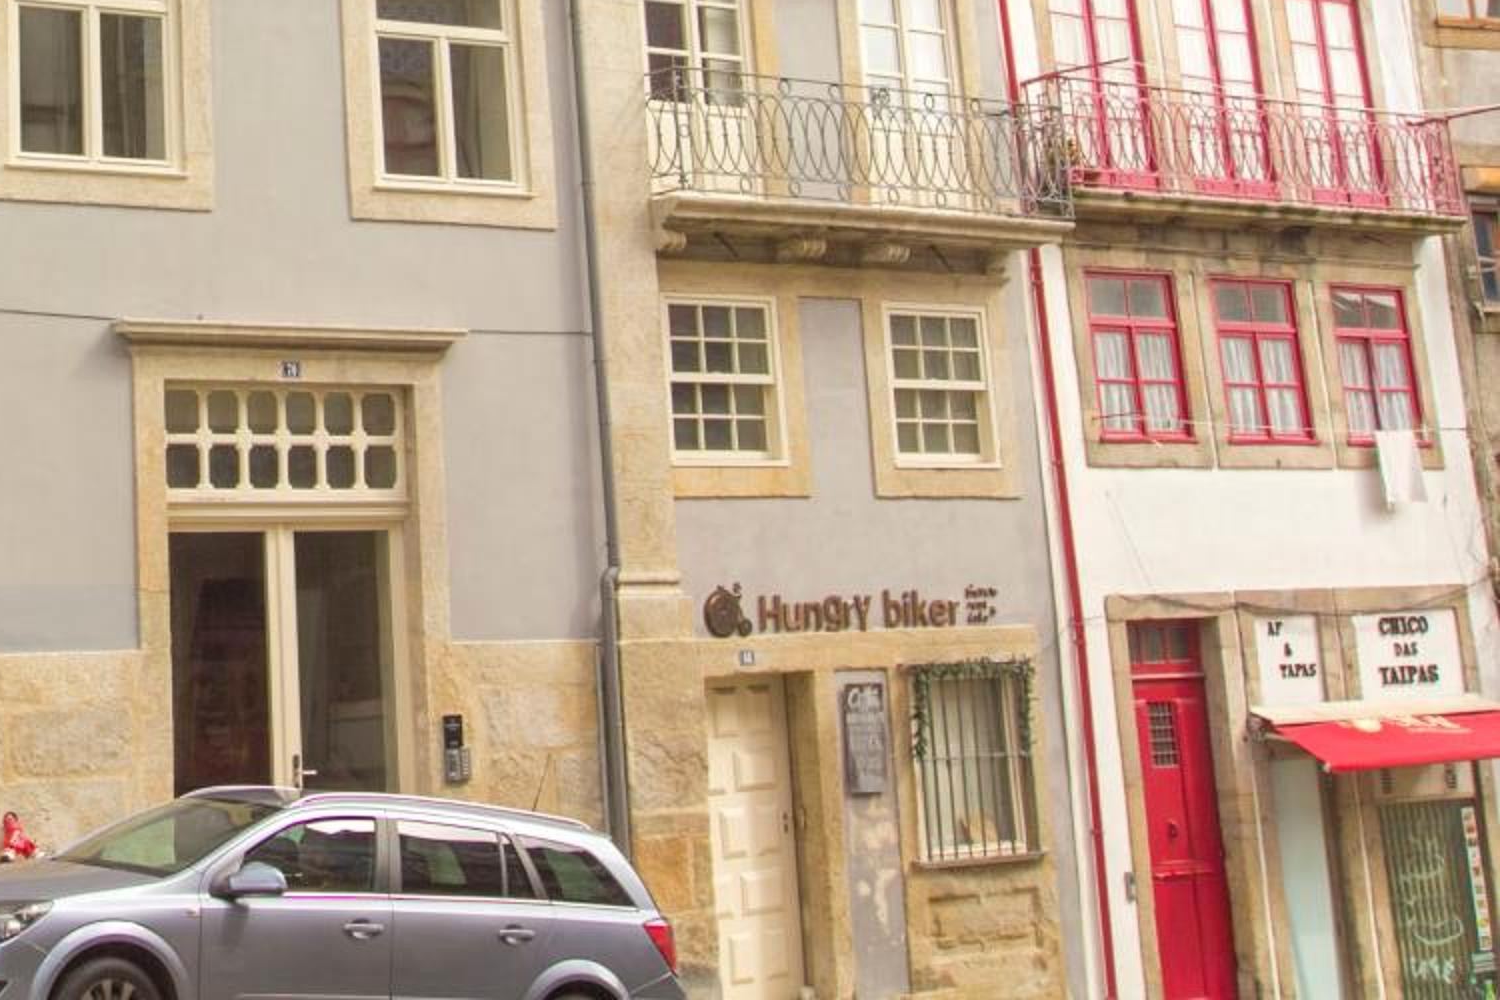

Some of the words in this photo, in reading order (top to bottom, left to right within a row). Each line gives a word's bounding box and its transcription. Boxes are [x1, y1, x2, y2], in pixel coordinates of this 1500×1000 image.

[882, 588, 960, 629] biker
[1378, 615, 1429, 637] CHICO
[1393, 642, 1418, 657] DAS
[1279, 663, 1317, 679] TAPAS
[1378, 664, 1440, 685] TAIPAS
